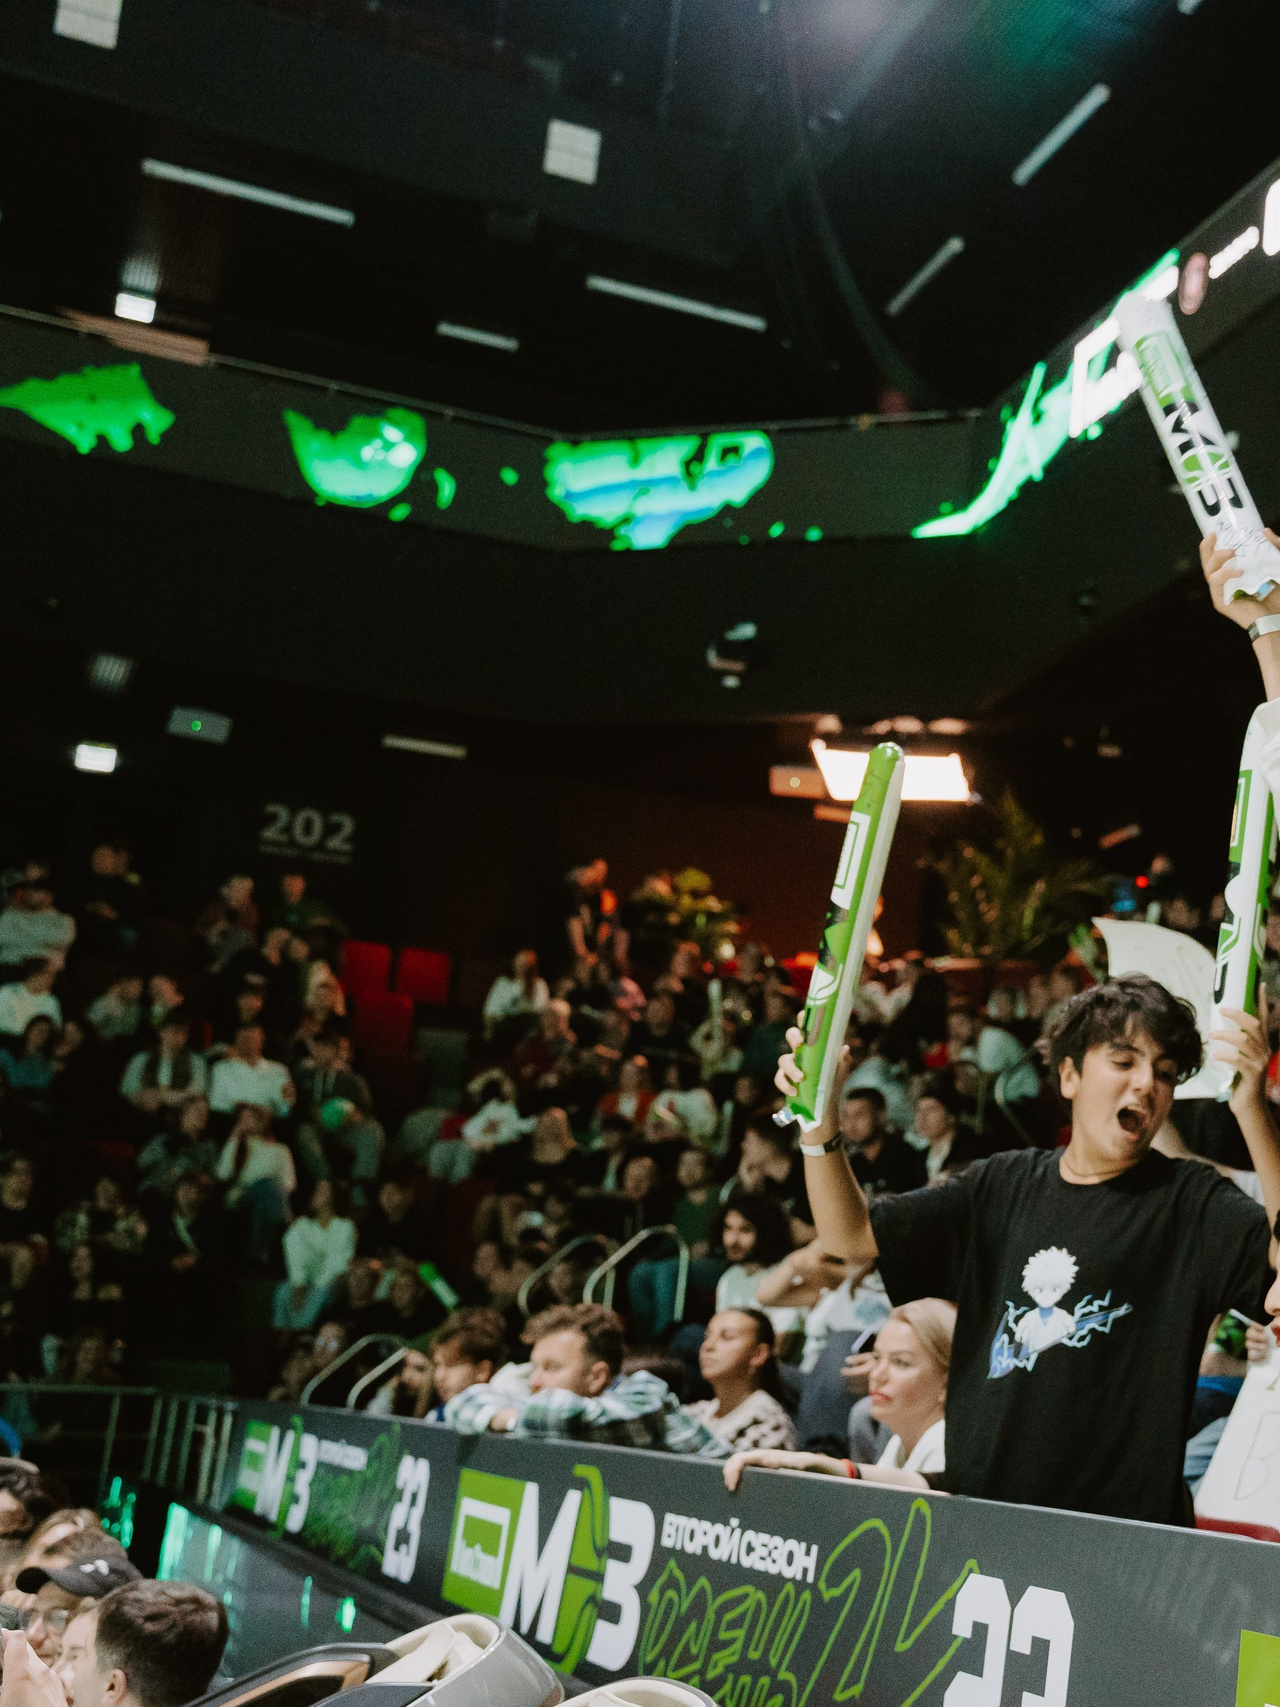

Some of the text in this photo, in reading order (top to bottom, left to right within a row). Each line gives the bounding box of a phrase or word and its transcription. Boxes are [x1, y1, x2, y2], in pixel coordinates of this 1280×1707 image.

[261, 803, 355, 851] 202
[381, 1454, 431, 1584] 23
[660, 1512, 819, 1584] ВТОРОЙ СЕЗОН
